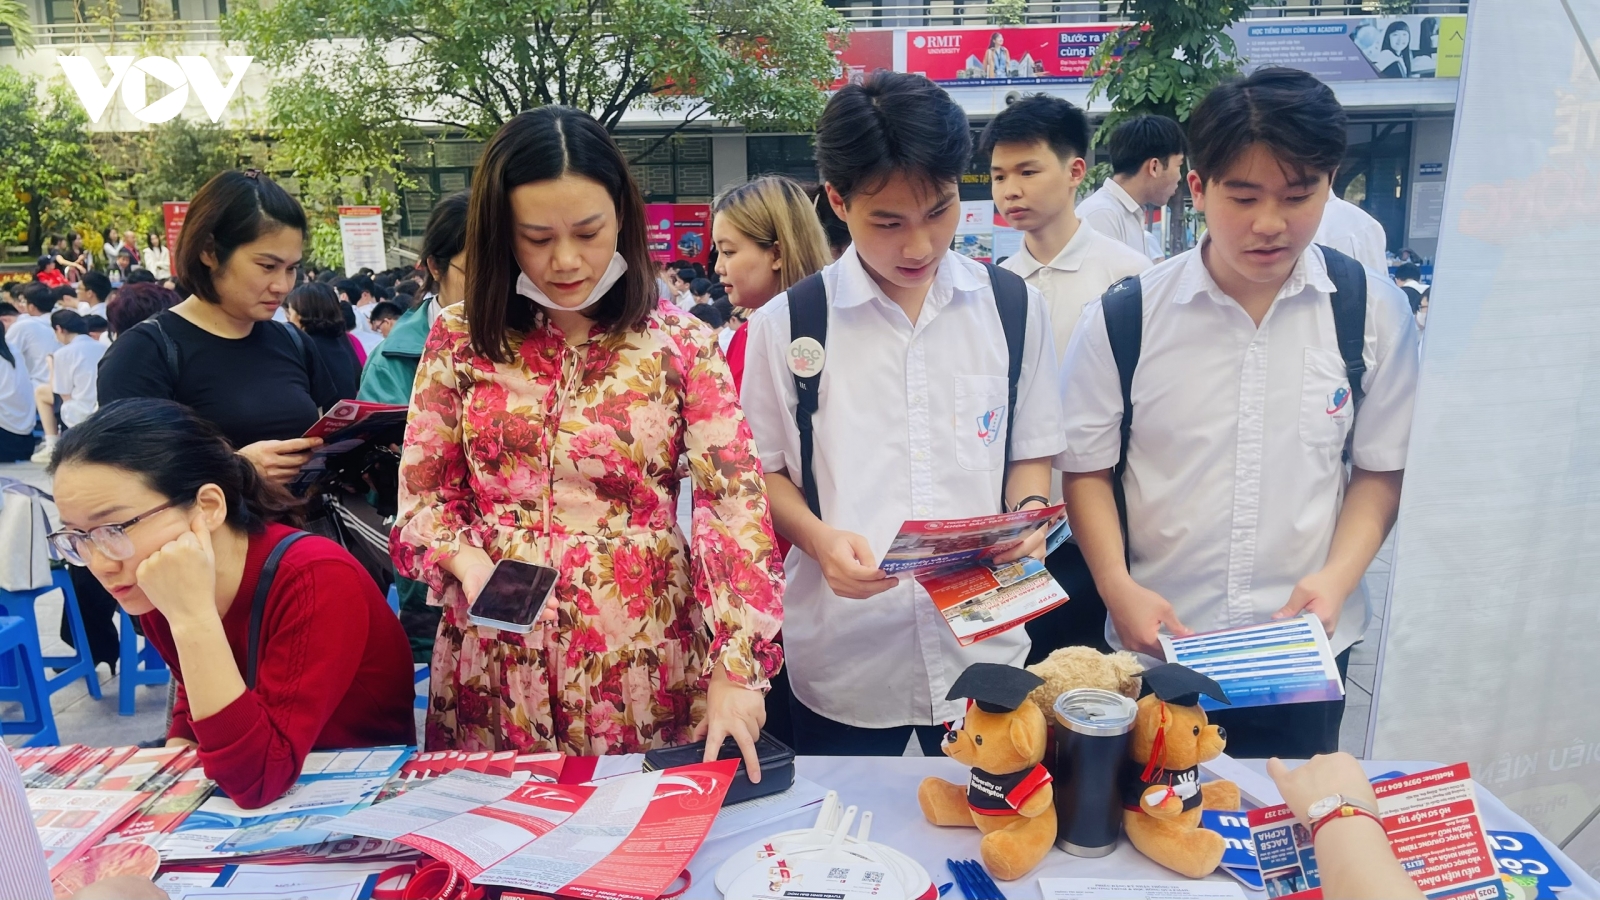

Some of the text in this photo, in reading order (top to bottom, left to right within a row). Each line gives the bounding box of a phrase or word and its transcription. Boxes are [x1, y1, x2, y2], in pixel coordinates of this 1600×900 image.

[1318, 25, 1344, 33] ACADEMY
[927, 35, 962, 47] RMIT
[1060, 33, 1087, 43] Bước
[1089, 34, 1101, 42] ra
[1060, 46, 1086, 57] cùng
[1374, 769, 1454, 793] Hotline: 0976 604 719
[1397, 806, 1451, 824] HỒ SƠ NỘP TẠI
[1257, 828, 1286, 840] ACPHA
[1437, 827, 1452, 836] NGỮ
[1451, 823, 1471, 833] NGÔN
[1259, 837, 1288, 850] AACSB
[1397, 830, 1473, 855] VÀO HỌC CHƯƠNG TRÌNH
[1438, 851, 1458, 862] KHÓA
[1457, 846, 1478, 858] CHÍNH
[1405, 858, 1424, 869] IELTS
[1427, 855, 1438, 863] với
[1407, 855, 1481, 878] VÀO HỌC CHƯƠNG TRÌN
[1417, 874, 1441, 888] ĐĂNG
[1440, 868, 1461, 883] KIỆN
[1477, 886, 1496, 897] 2025
